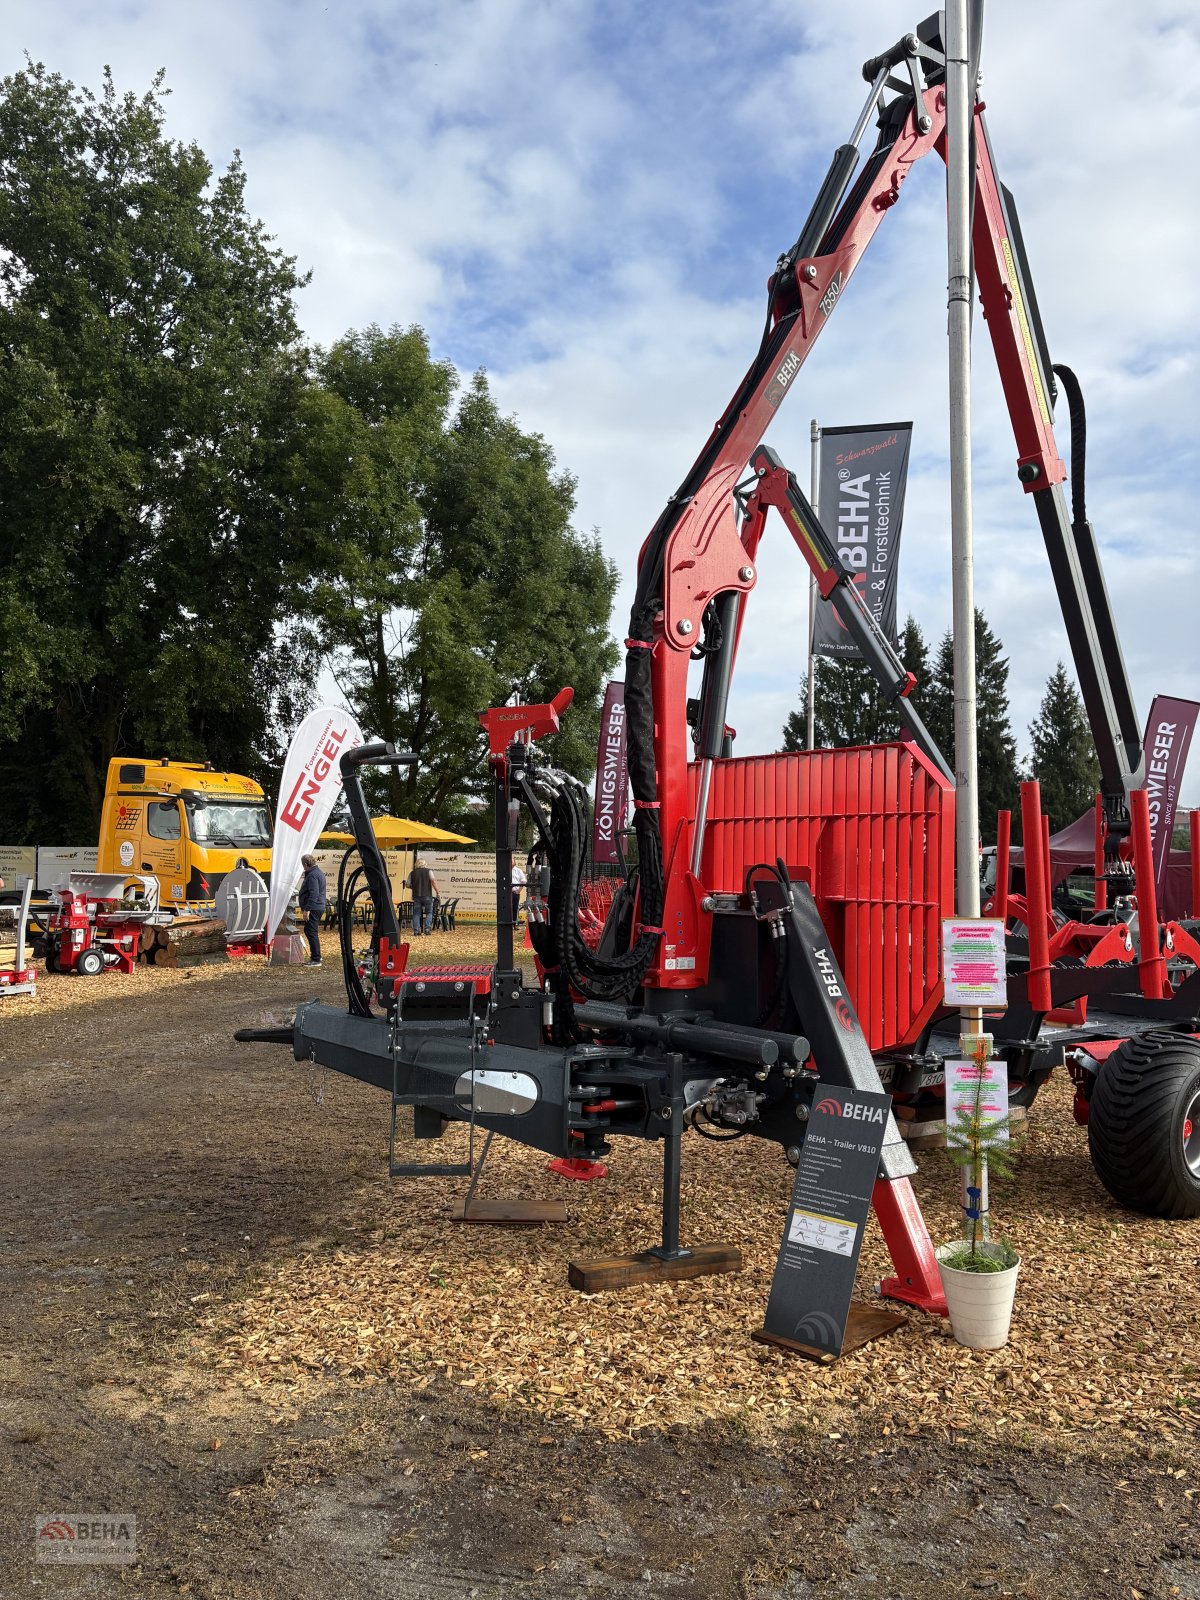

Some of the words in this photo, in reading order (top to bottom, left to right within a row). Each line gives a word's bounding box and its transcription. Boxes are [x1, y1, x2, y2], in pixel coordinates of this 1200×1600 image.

[776, 351, 801, 387] BEHA
[835, 434, 898, 466] Schwarzwald
[871, 471, 891, 573] Forsttechnik
[870, 578, 886, 591] &
[279, 728, 348, 833] ENGEL
[595, 703, 626, 841] KÖNIGSWIESER
[1167, 785, 1176, 801] 1972
[1164, 803, 1173, 825] SINCE
[813, 948, 842, 997] BEHA
[842, 1102, 884, 1124] BEHA
[807, 1134, 826, 1145] BEHA
[834, 1139, 856, 1150] Trailer
[857, 1143, 877, 1154] V810
